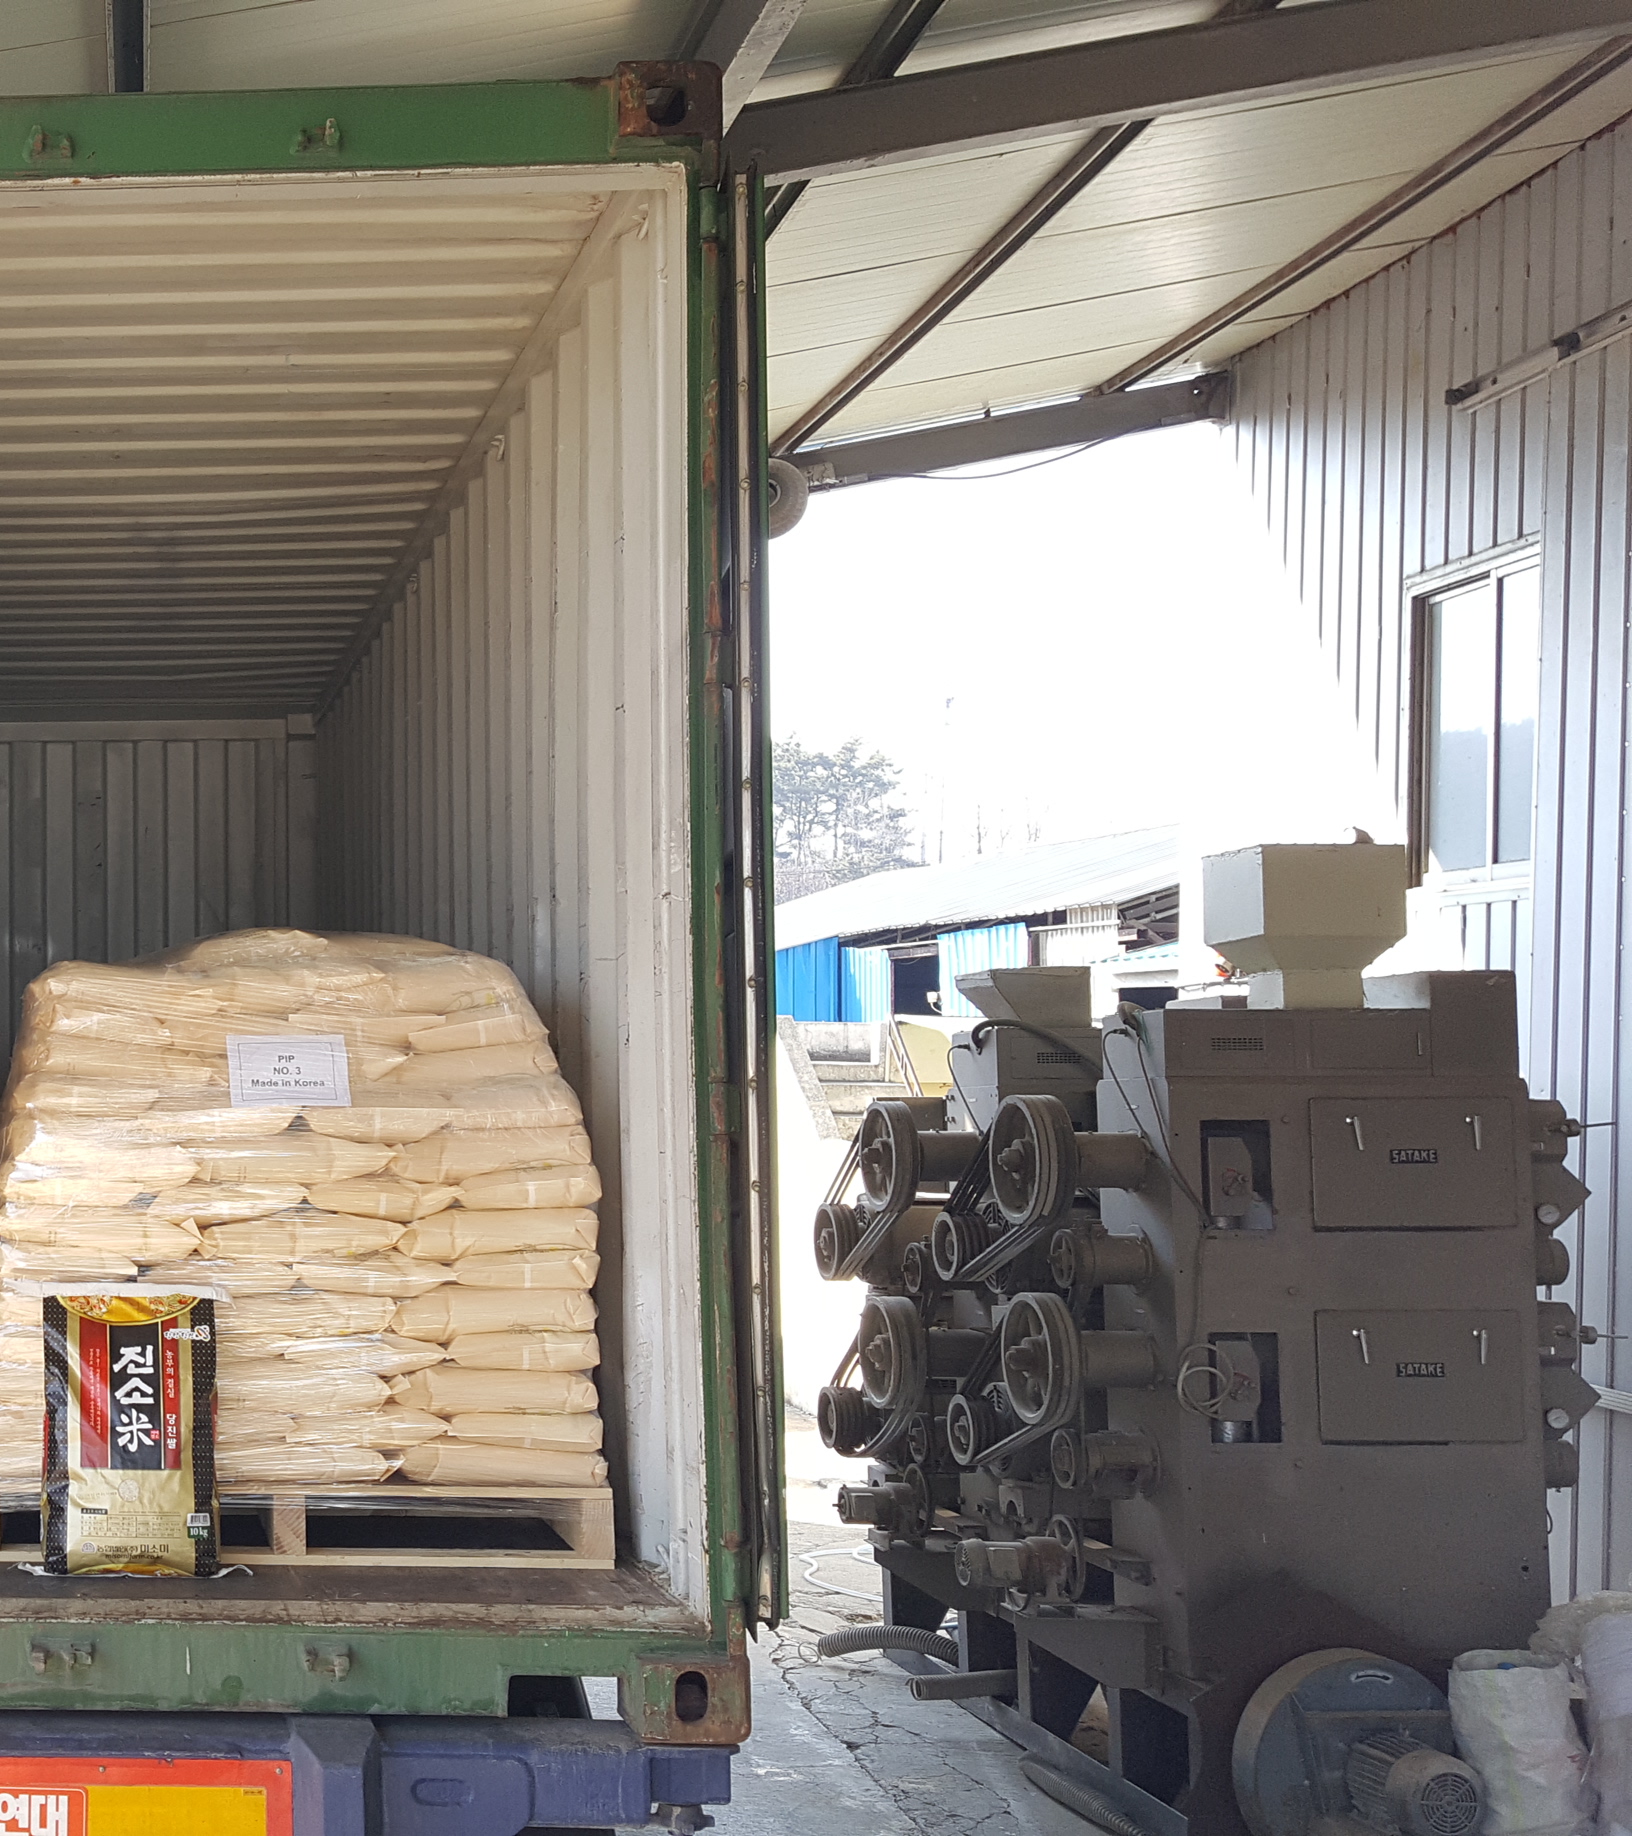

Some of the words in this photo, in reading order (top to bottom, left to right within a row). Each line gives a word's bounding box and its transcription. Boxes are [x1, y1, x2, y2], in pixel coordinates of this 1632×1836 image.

[277, 1055, 295, 1063] PIP
[273, 1067, 293, 1075] NO.
[295, 1067, 301, 1075] 3
[251, 1079, 279, 1087] Made
[281, 1079, 291, 1087] in
[294, 1079, 325, 1087] Korea
[1392, 1150, 1436, 1163] SATAKE
[1399, 1363, 1444, 1376] SATAKE
[112, 1345, 155, 1452] 진소米
[140, 1544, 169, 1554] 미소미
